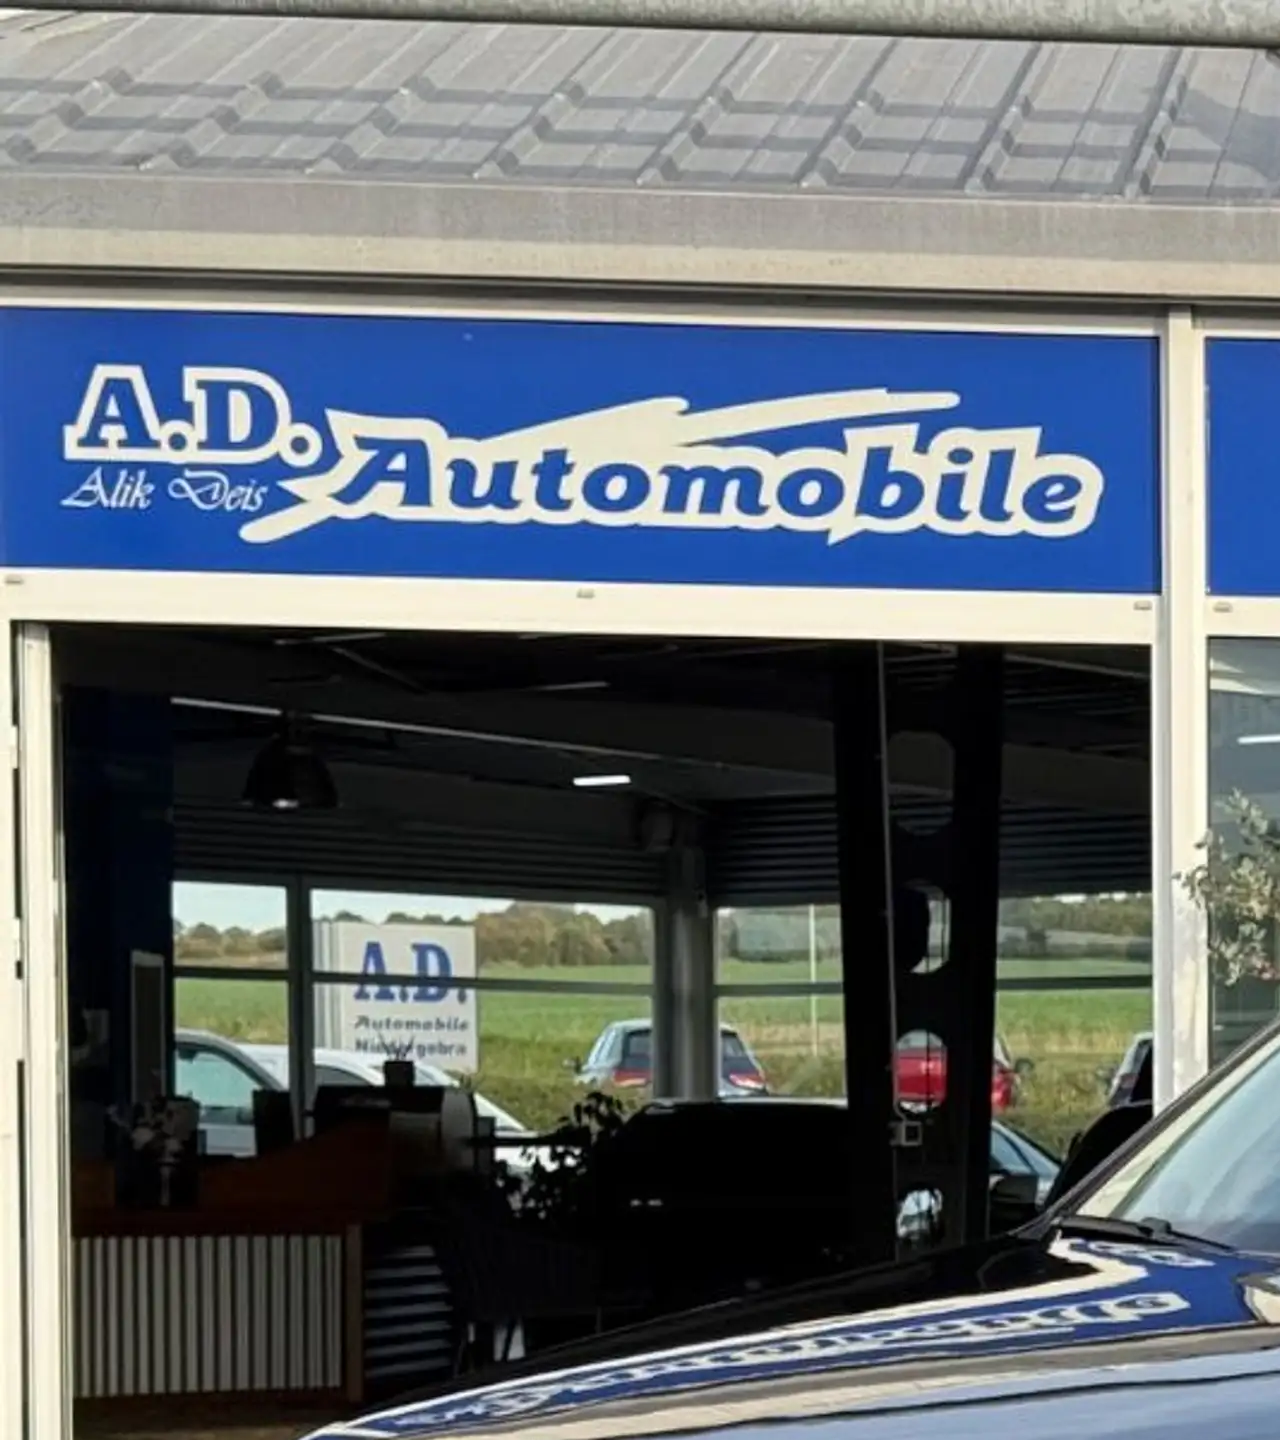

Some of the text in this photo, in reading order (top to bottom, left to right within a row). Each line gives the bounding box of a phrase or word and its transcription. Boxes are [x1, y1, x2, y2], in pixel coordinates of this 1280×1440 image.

[63, 364, 1104, 546] A.D. Automobile
[60, 466, 268, 512] Alik Deis
[353, 941, 467, 1004] A.D.
